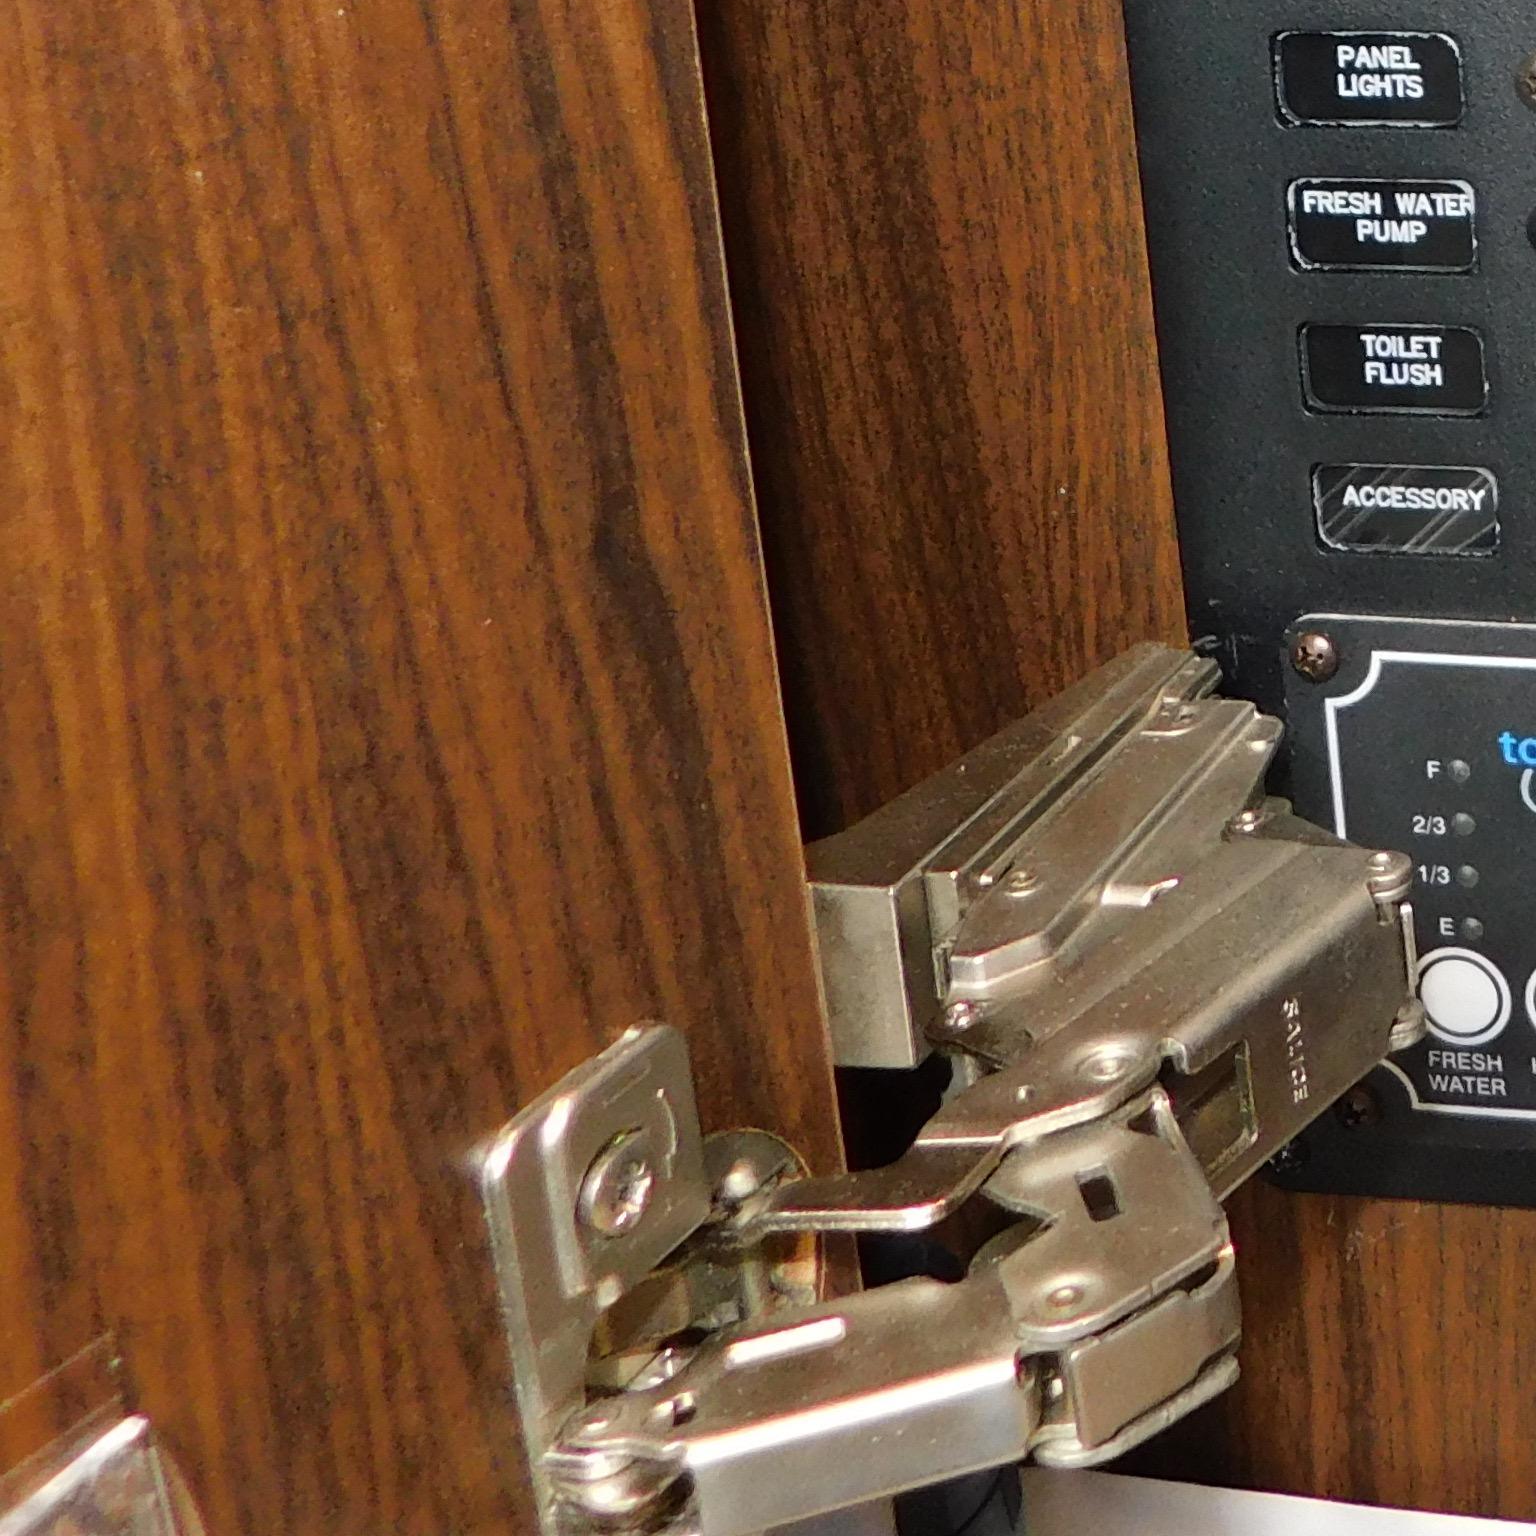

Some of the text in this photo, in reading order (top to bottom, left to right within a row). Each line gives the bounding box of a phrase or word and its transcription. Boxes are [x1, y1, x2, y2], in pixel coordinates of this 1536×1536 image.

[1337, 45, 1421, 70] PANEL
[1337, 73, 1424, 99] LIGHTS
[1302, 189, 1473, 218] FRESH WATER
[1356, 218, 1427, 243] PUMP
[1359, 334, 1442, 359] TOILET
[1364, 361, 1443, 386] FLUSH
[1342, 484, 1486, 511] ACCESSORY
[1426, 760, 1441, 779] F
[1412, 815, 1446, 835] 2/3
[1418, 864, 1450, 885] 1/3
[1439, 917, 1455, 936] E
[1428, 1050, 1503, 1072] FRESH
[1428, 1074, 1507, 1096] WATER
